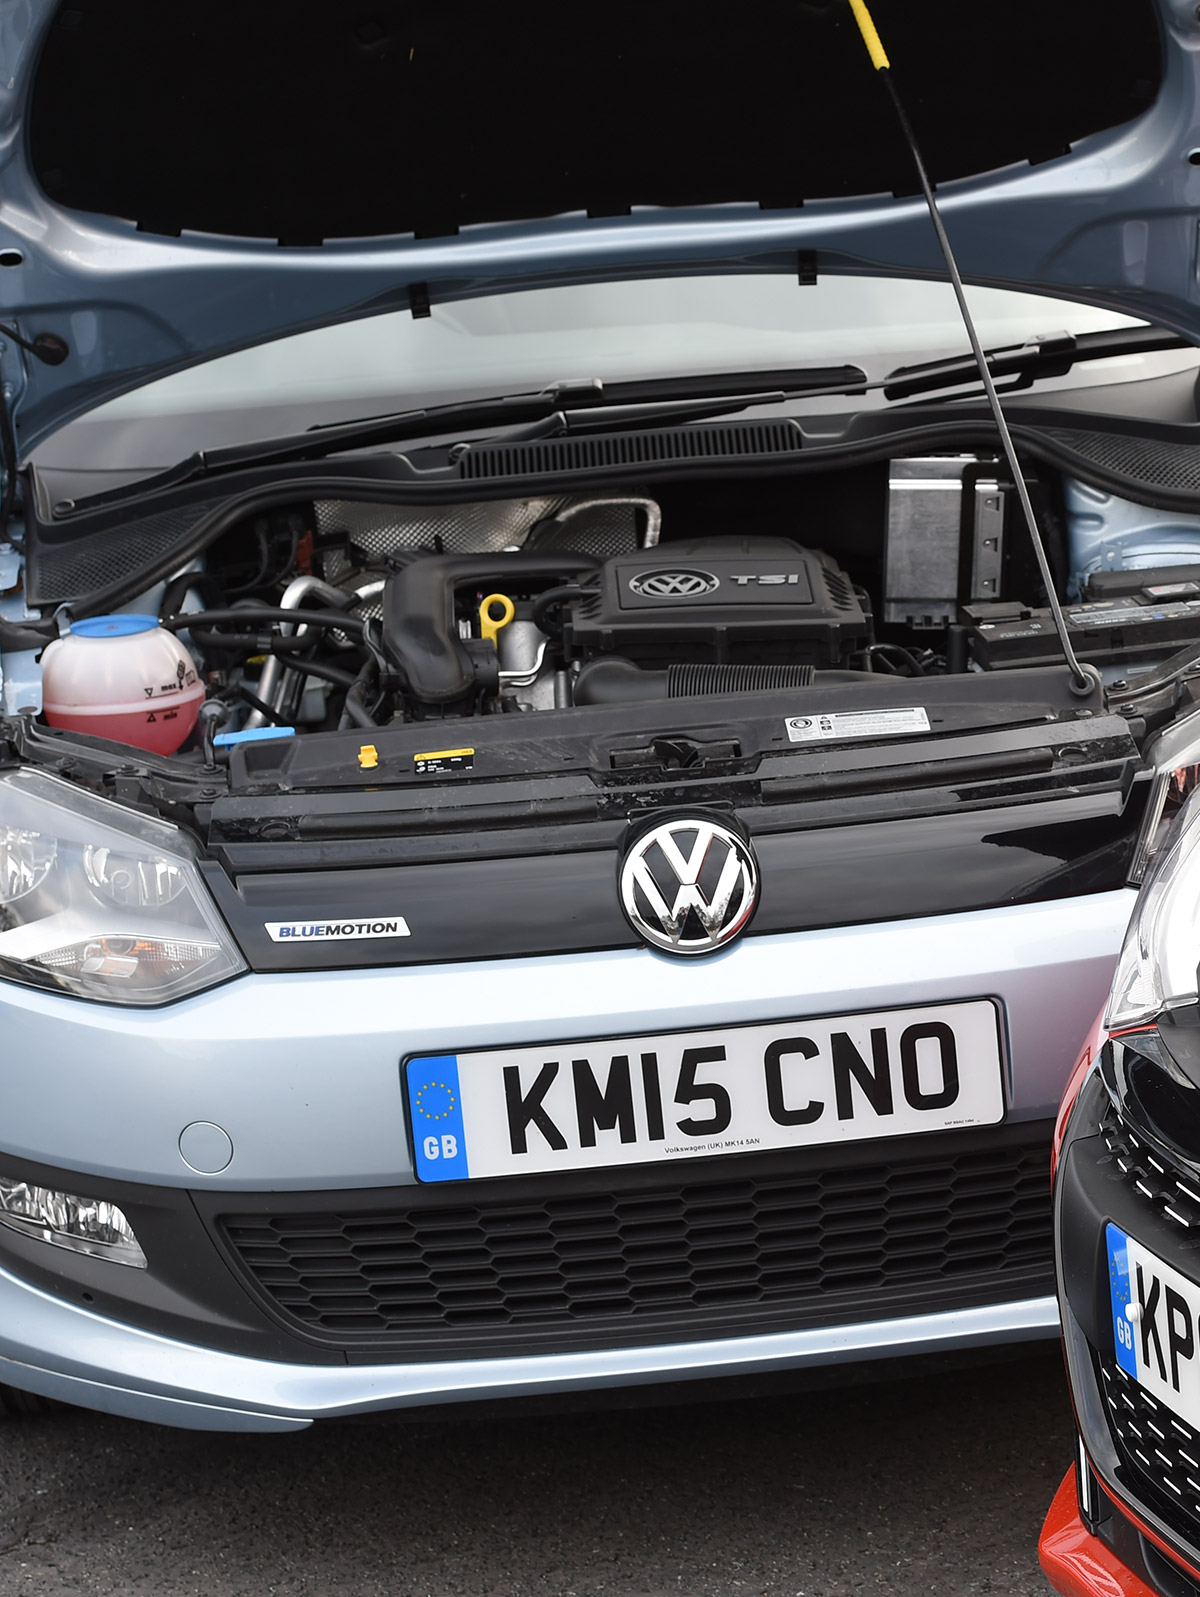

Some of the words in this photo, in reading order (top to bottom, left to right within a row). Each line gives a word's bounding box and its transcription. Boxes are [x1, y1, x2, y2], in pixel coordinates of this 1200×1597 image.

[730, 574, 799, 586] TSI
[161, 683, 177, 692] max
[163, 711, 178, 721] min
[621, 819, 757, 953] VW
[279, 922, 398, 938] BLUEMOTION
[503, 1045, 732, 1155] KM15
[764, 1021, 959, 1126] CNO
[423, 1134, 458, 1160] GB
[664, 1143, 706, 1154] Volkswagen
[707, 1142, 724, 1150] (UK)
[746, 1137, 760, 1145] 5AN
[1117, 1316, 1132, 1350] GB
